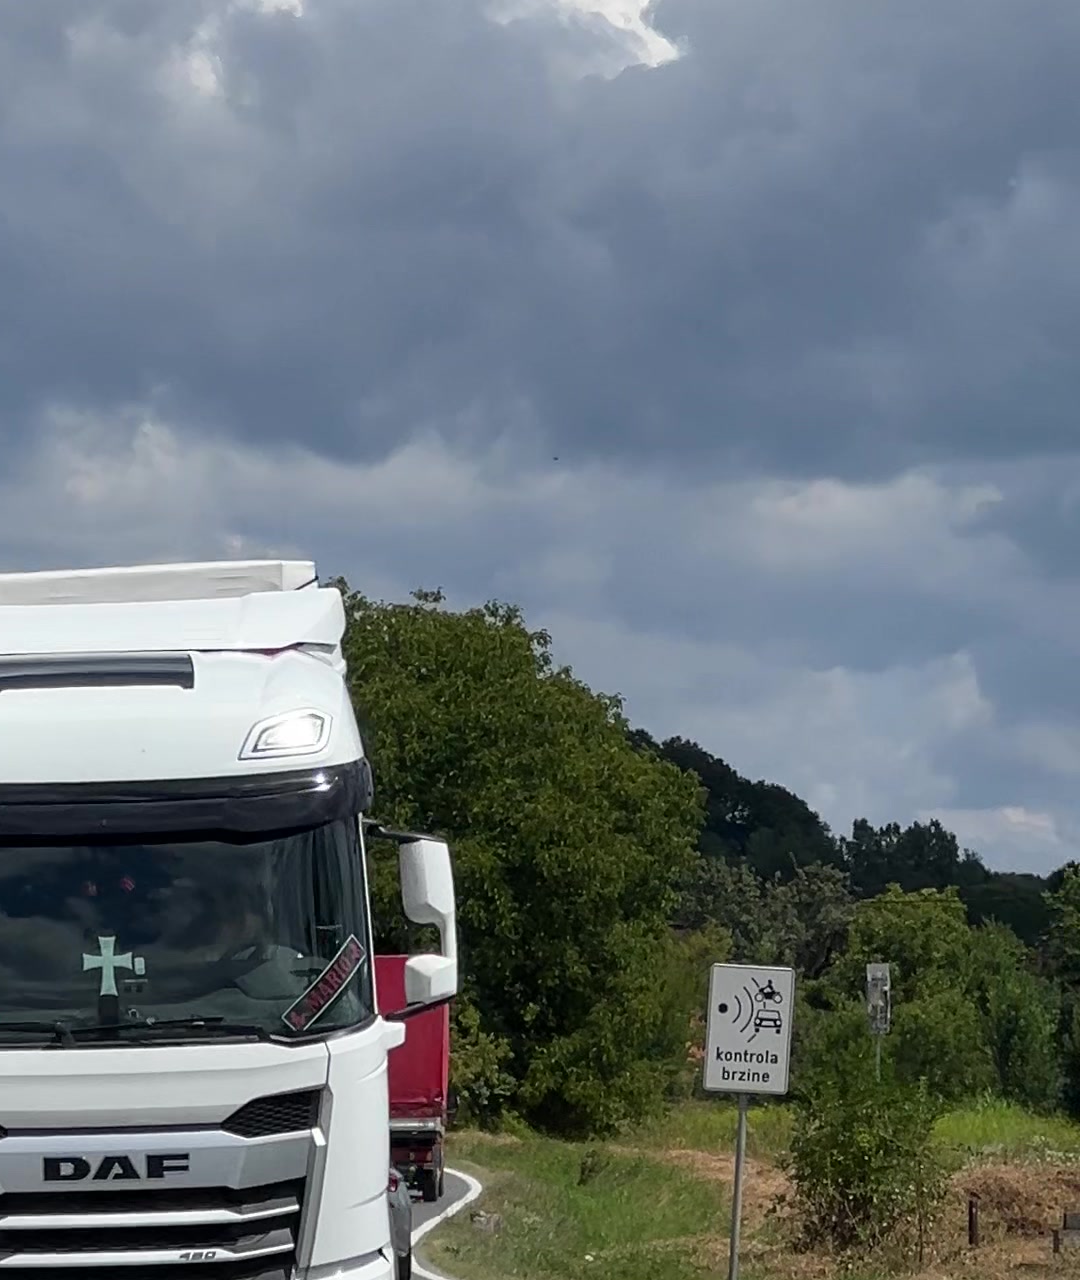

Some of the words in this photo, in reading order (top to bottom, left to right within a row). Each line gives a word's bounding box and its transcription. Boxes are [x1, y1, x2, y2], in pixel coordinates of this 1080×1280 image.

[716, 1046, 778, 1064] kontrola
[721, 1066, 770, 1082] brzine
[43, 1153, 190, 1181] DAF
